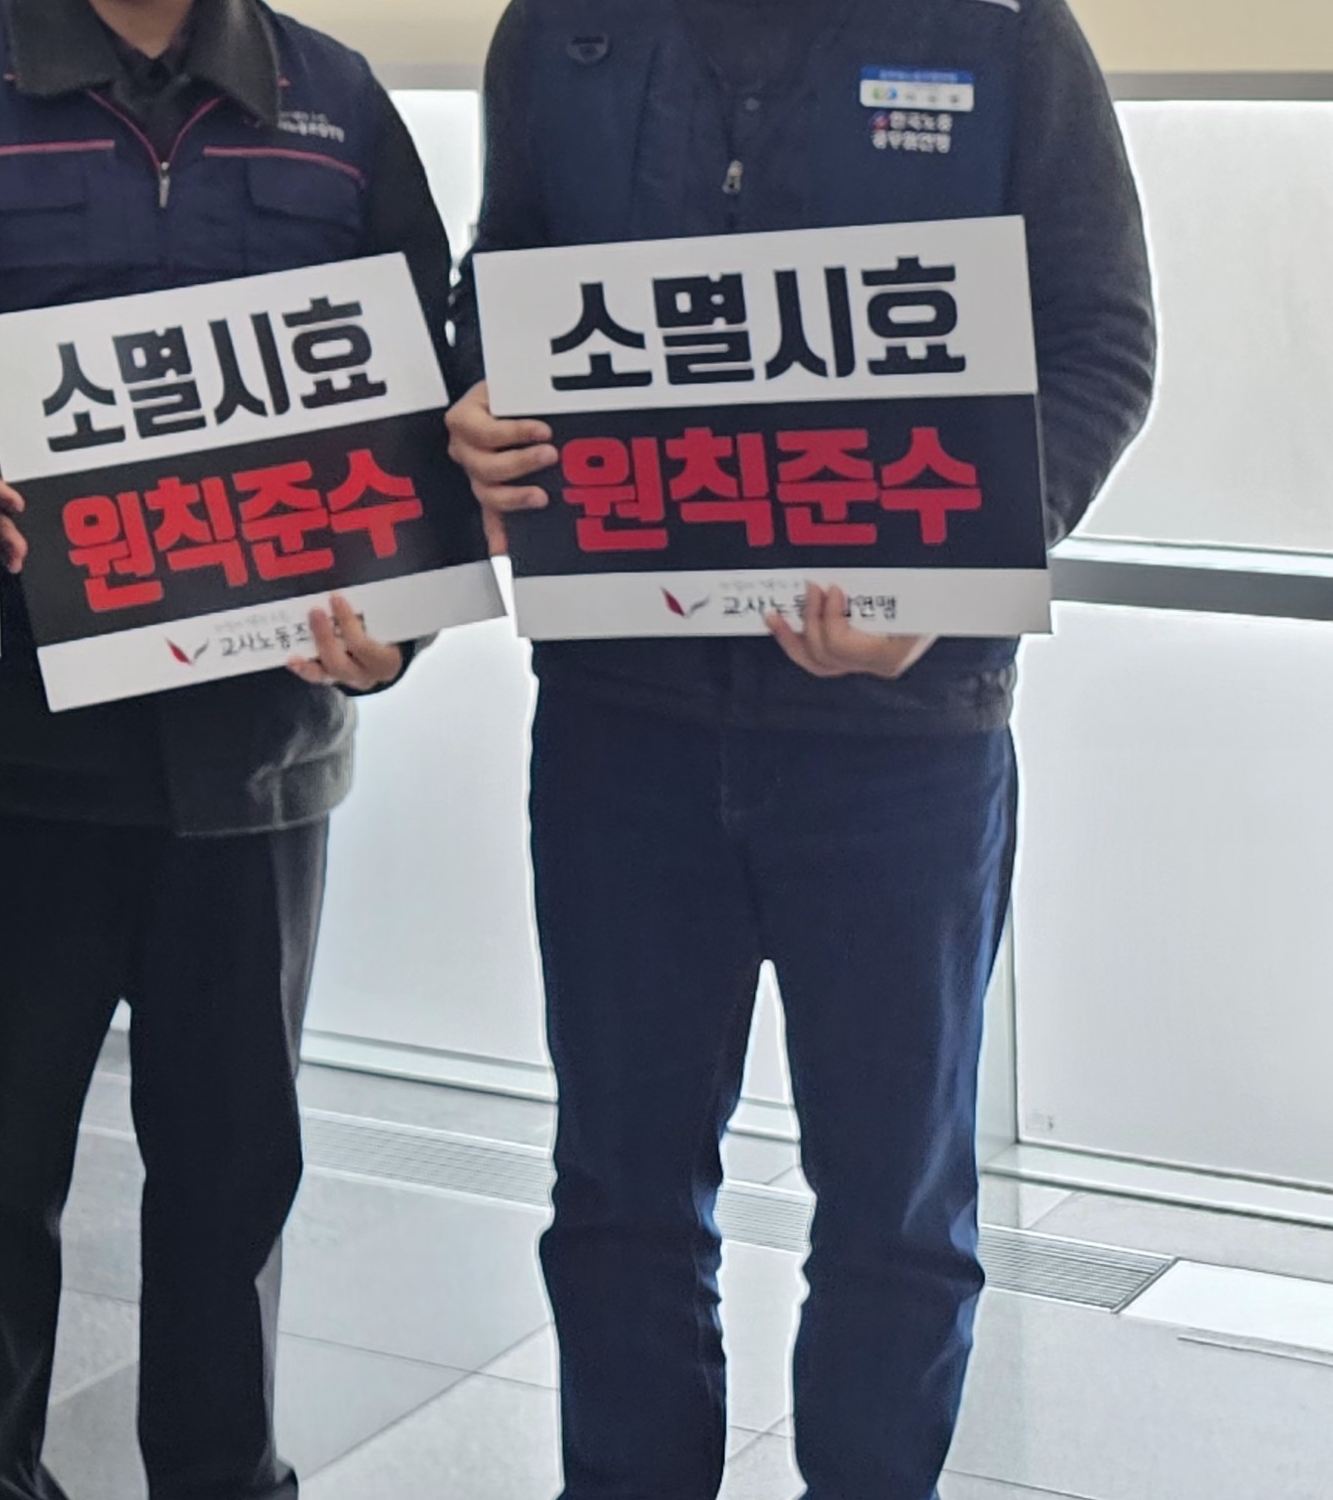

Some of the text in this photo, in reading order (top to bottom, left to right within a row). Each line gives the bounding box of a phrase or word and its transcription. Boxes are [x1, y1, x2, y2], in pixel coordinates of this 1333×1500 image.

[41, 296, 388, 453] 소멸시효
[549, 256, 967, 392] 소멸시효
[62, 449, 424, 613] 원칙준수
[561, 427, 983, 552] 원칙준수
